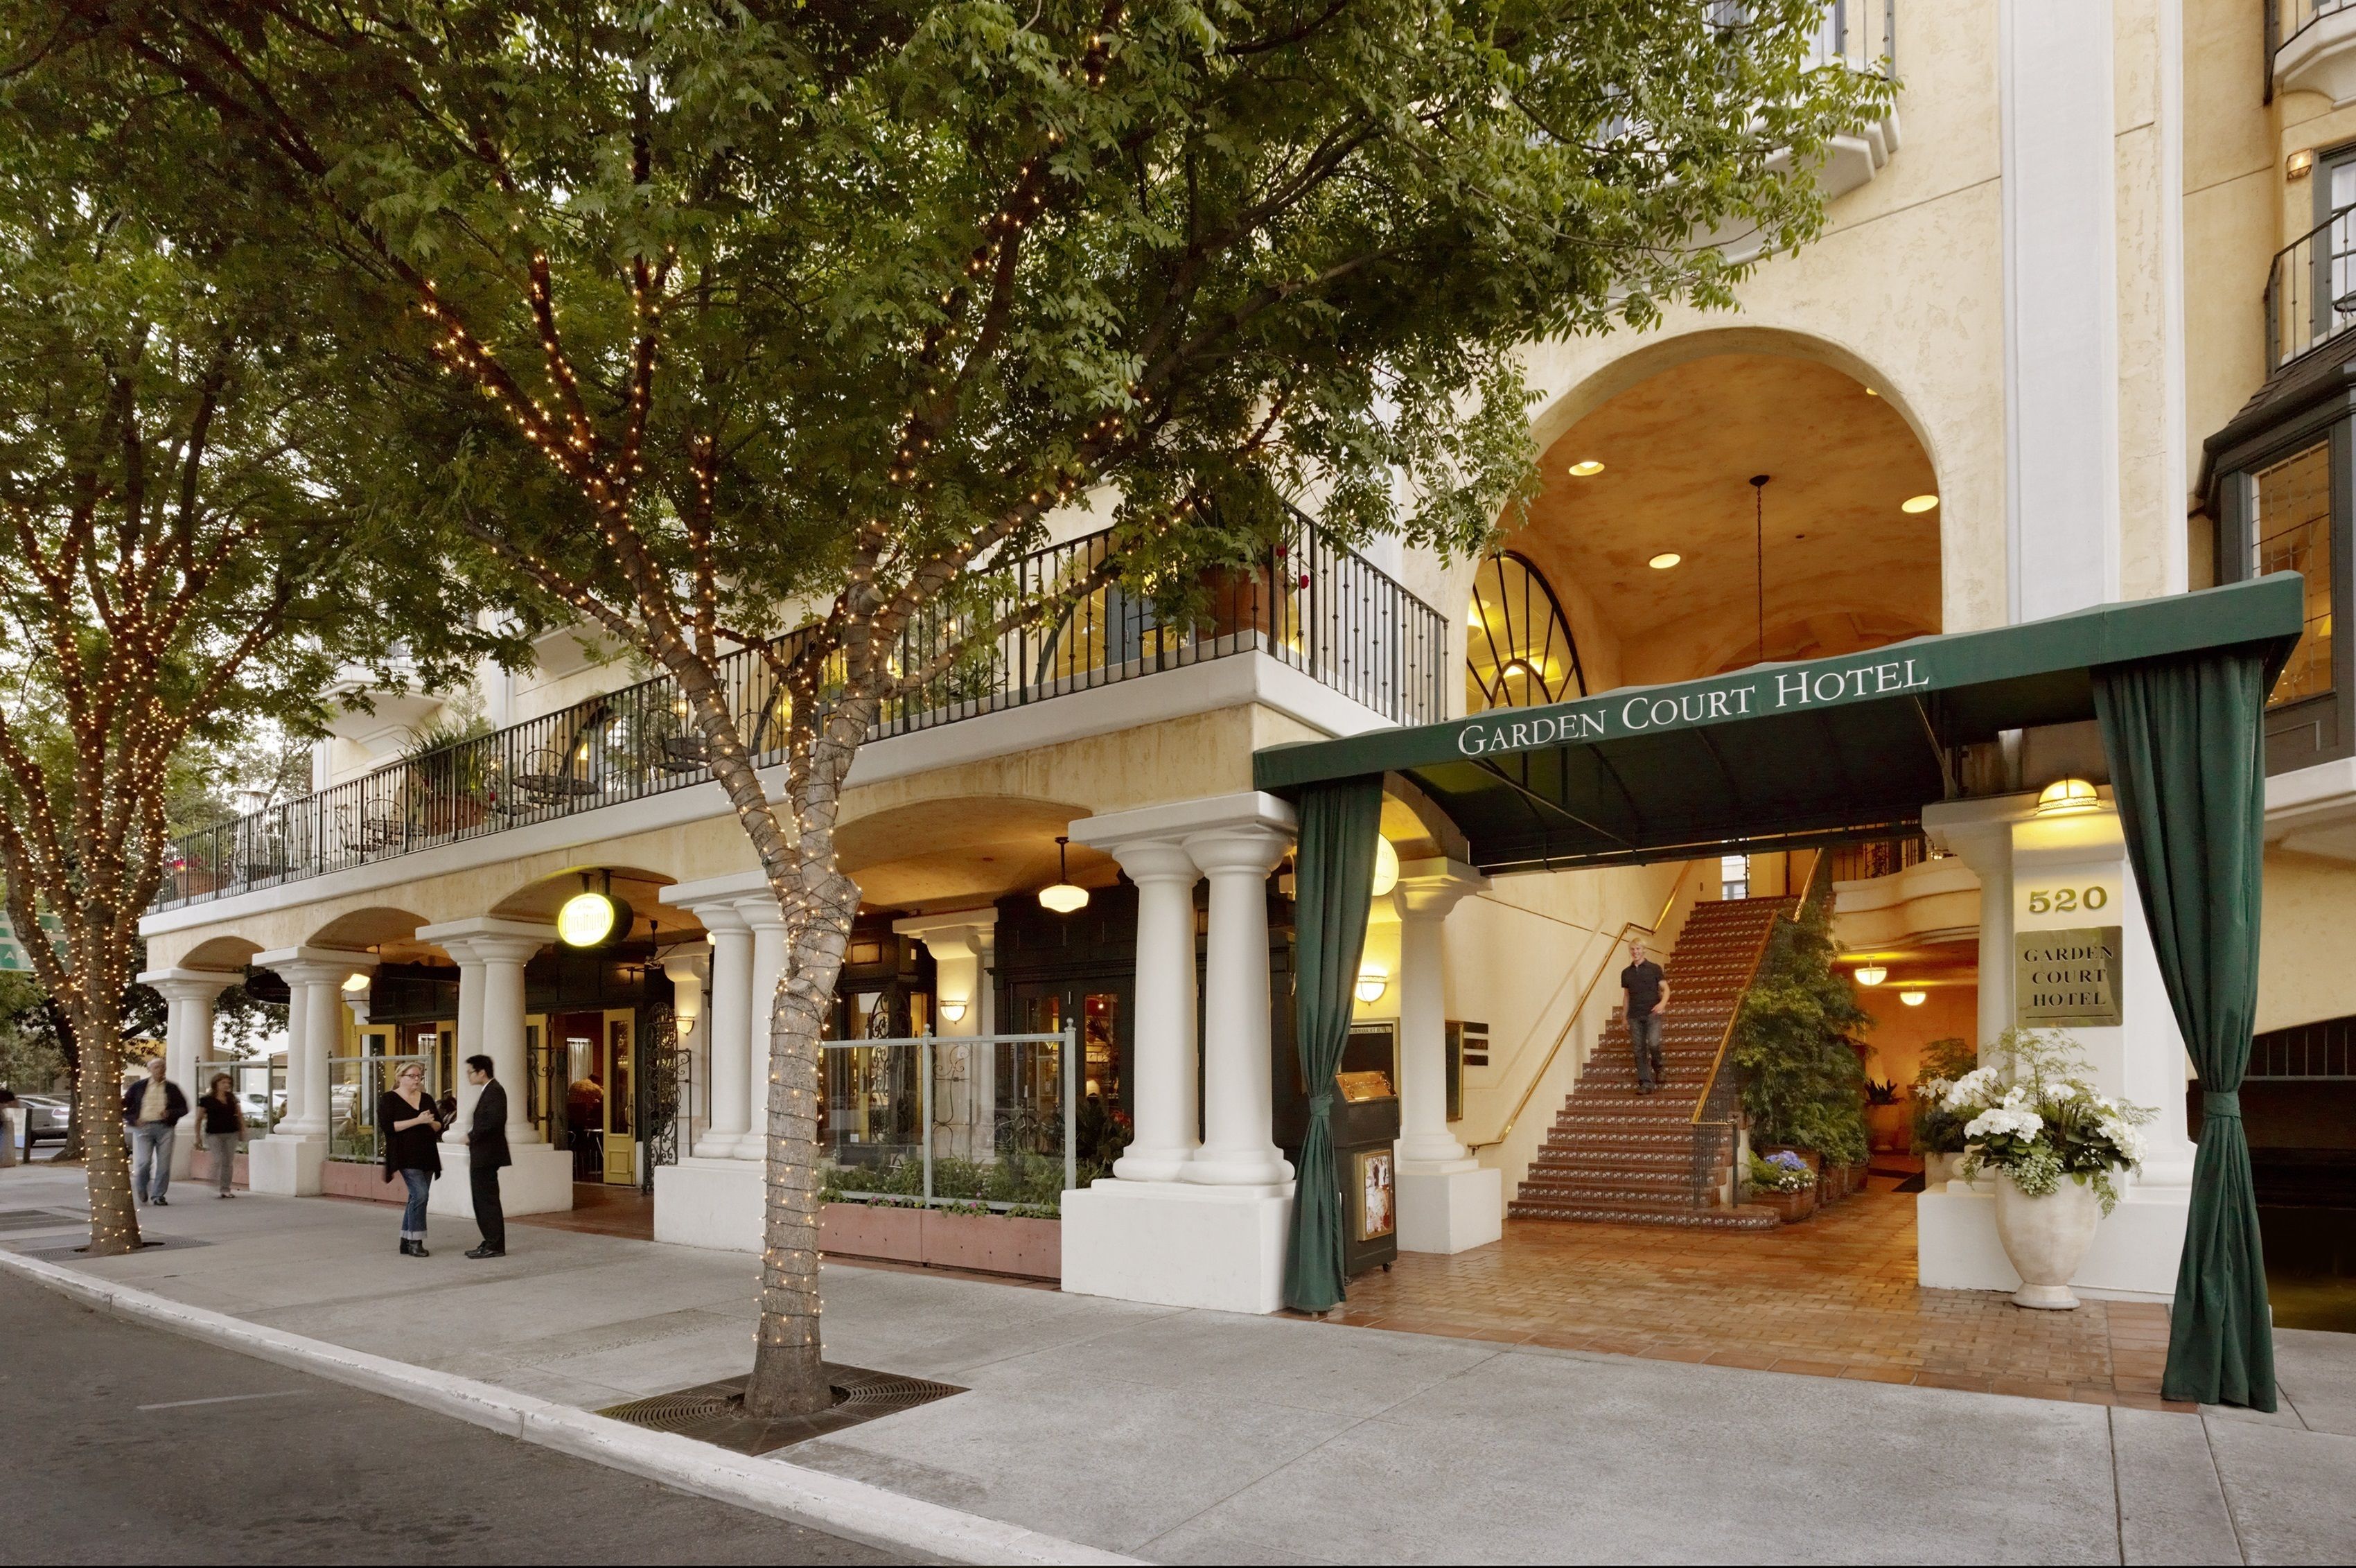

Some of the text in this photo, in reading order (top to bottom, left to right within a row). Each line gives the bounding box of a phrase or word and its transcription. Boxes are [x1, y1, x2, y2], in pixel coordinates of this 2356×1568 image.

[1458, 659, 1929, 755] GARDEN COURT HOTEL
[2028, 886, 2107, 914] 520
[2024, 946, 2113, 962] GARDEN
[2032, 969, 2106, 985] COURT
[2033, 992, 2106, 1007] HOTEL
